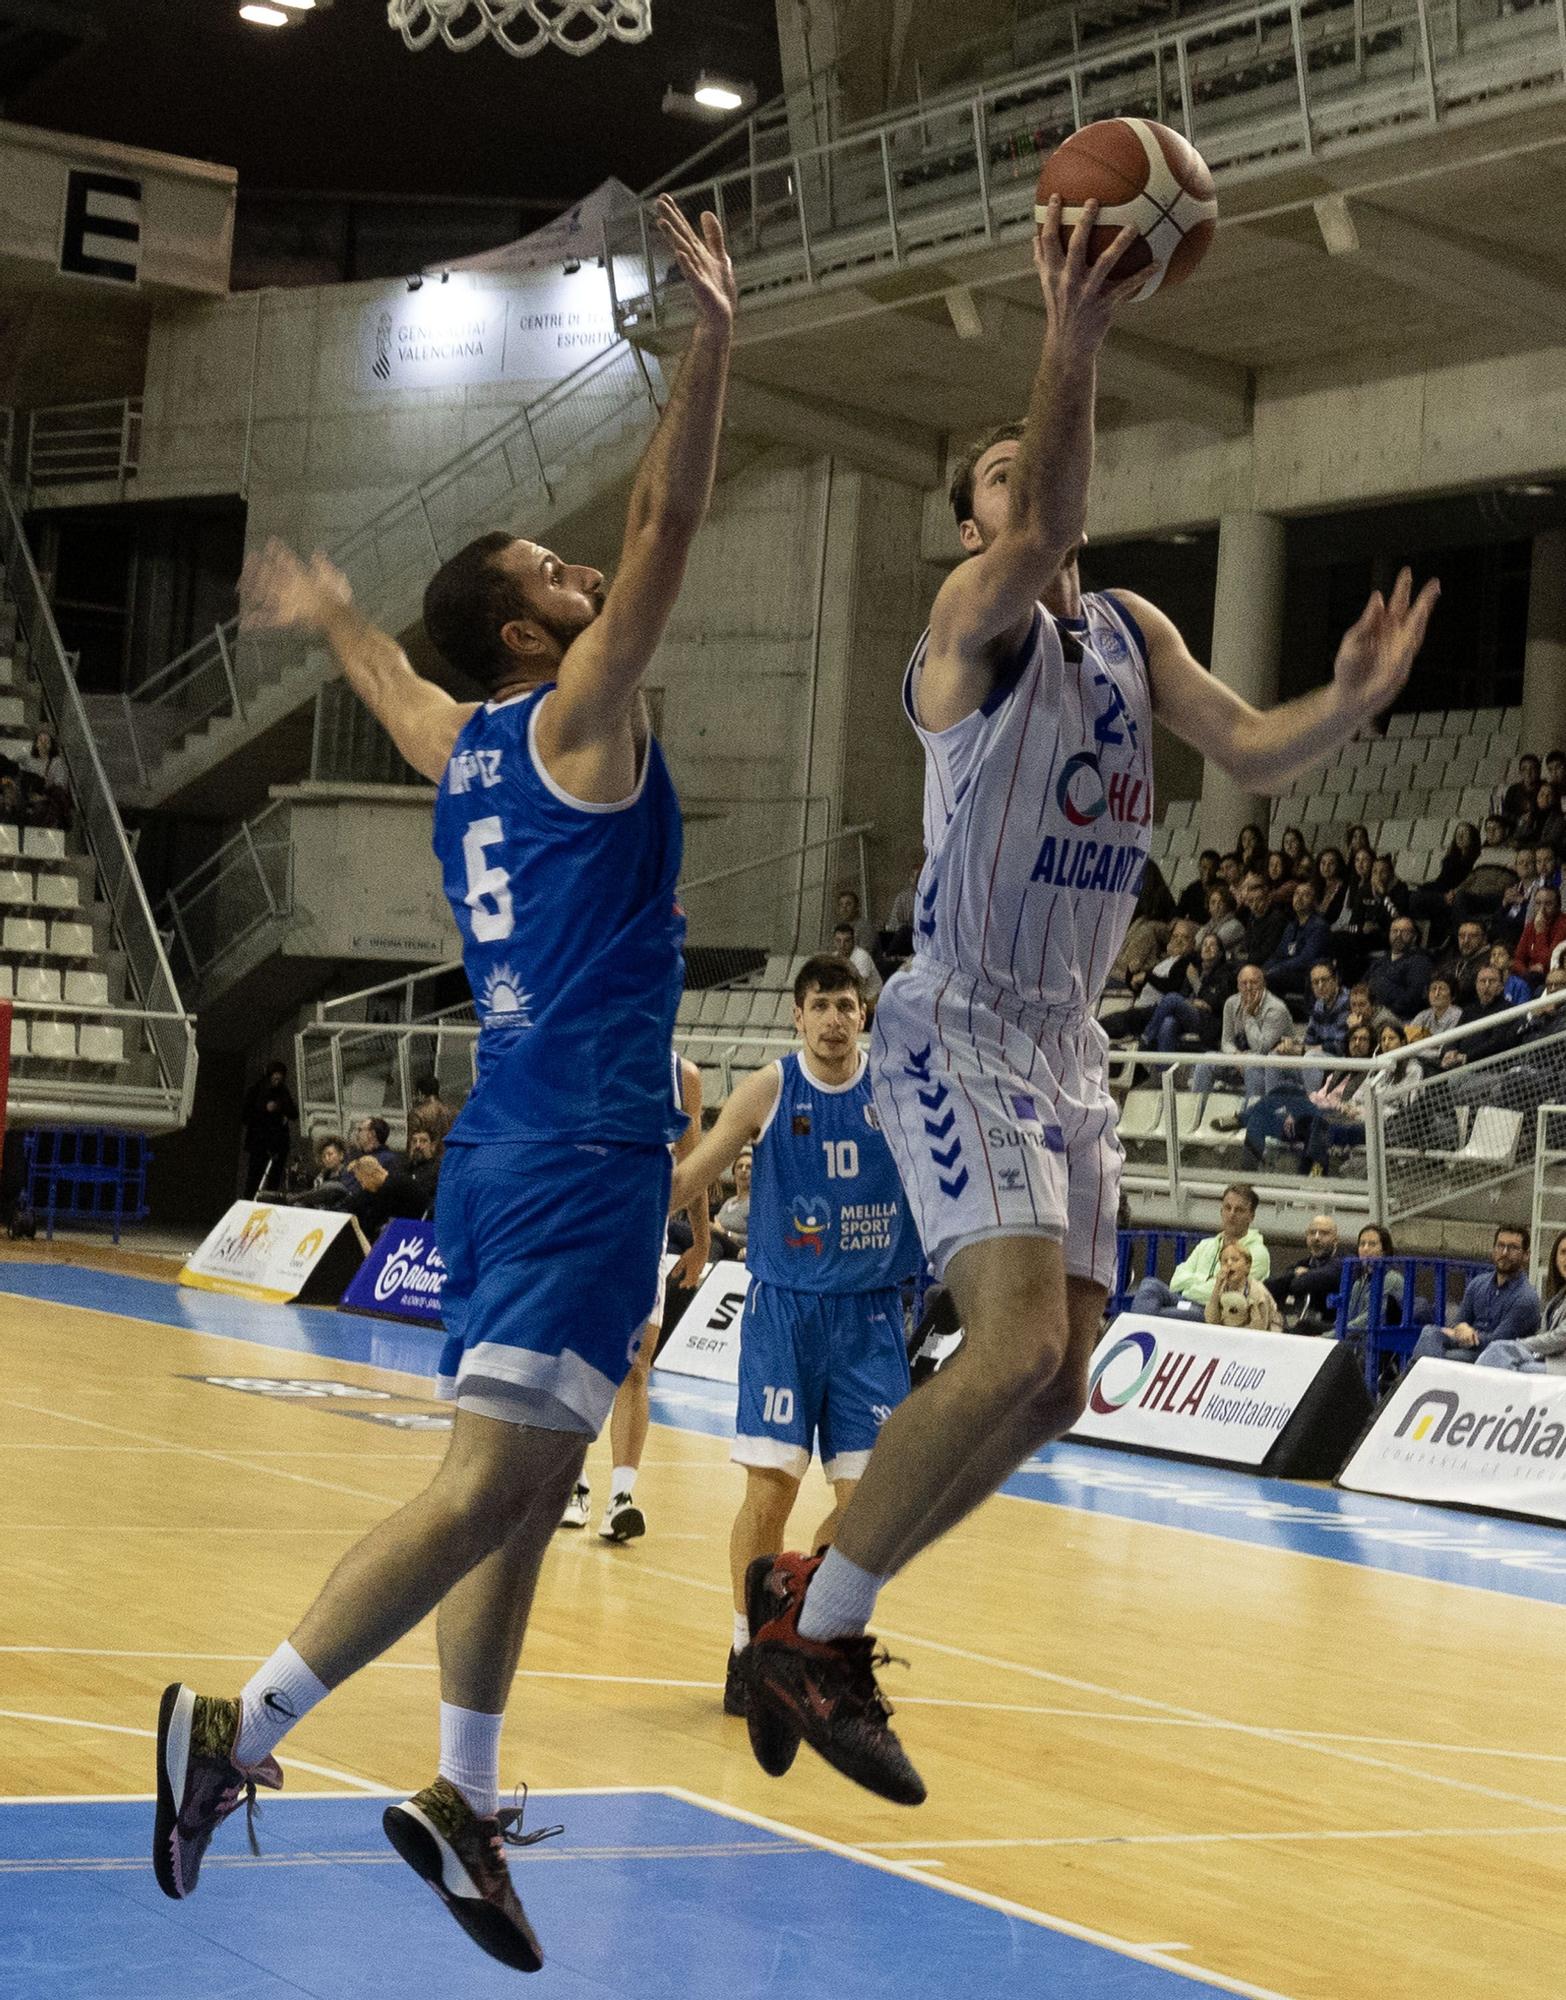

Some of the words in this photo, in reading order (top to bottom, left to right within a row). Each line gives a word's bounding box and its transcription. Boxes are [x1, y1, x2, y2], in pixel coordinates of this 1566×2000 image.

[61, 170, 142, 283] E
[519, 312, 564, 331] CENTRE
[463, 815, 515, 943] 6
[988, 1127, 1047, 1148] Sum
[822, 1140, 859, 1179] 10
[841, 1201, 897, 1220] MELILLA
[841, 1218, 890, 1235] SPORT
[686, 1336, 729, 1353] SEAT
[1139, 1351, 1220, 1416] HLA
[1220, 1361, 1266, 1392] Grupo
[762, 1385, 794, 1425] 10
[1201, 1393, 1292, 1431] Hospitalario
